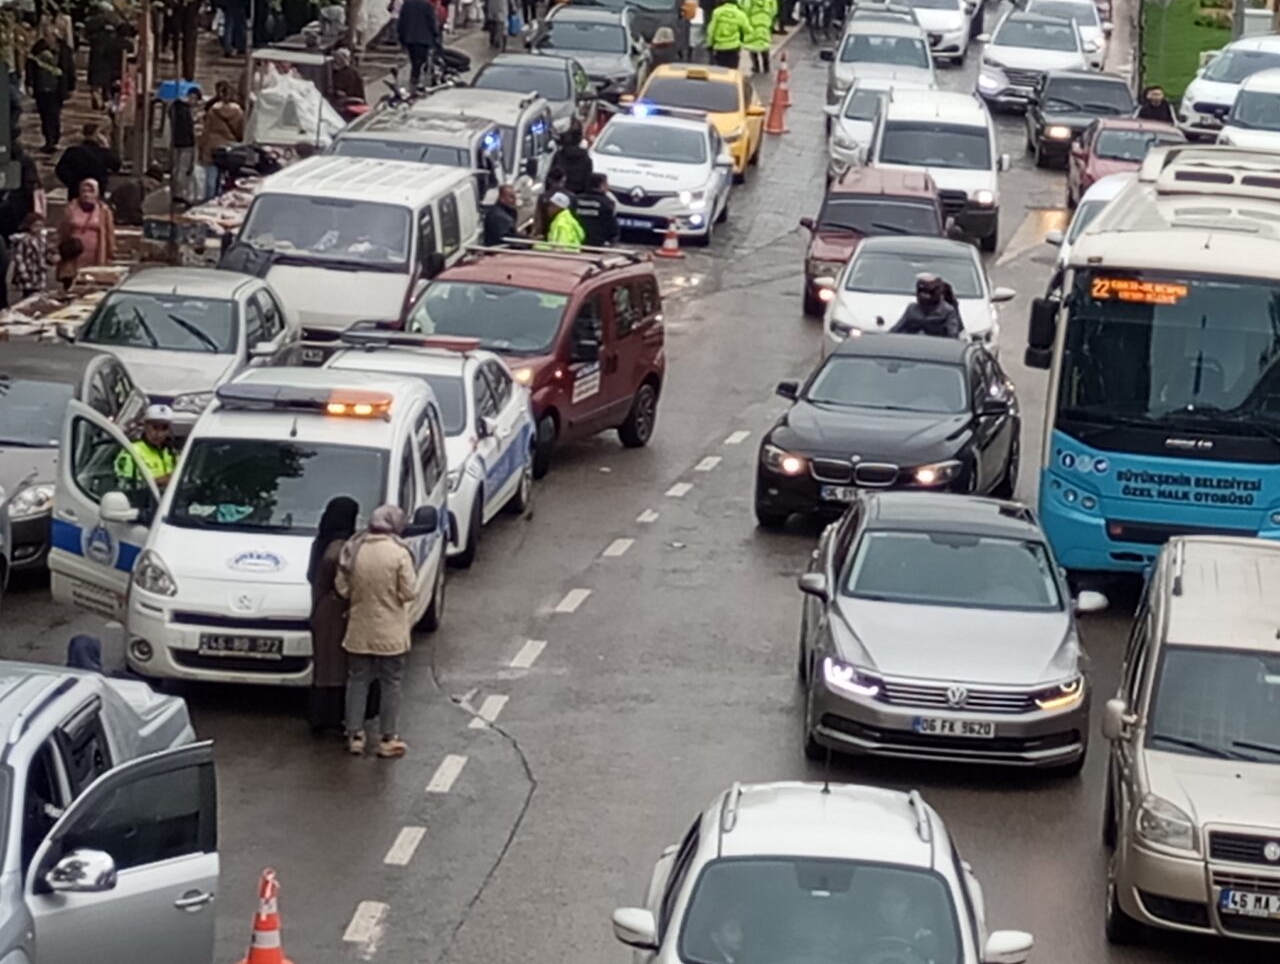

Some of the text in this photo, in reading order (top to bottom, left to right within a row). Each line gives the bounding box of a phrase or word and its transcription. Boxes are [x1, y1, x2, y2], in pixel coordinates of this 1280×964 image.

[1092, 278, 1110, 298] 22
[1116, 469, 1262, 492] BÜYÜKŞEHİR BELEDİYESİ
[1122, 485, 1254, 506] ÖZEL HALK OTOBÜSÜ
